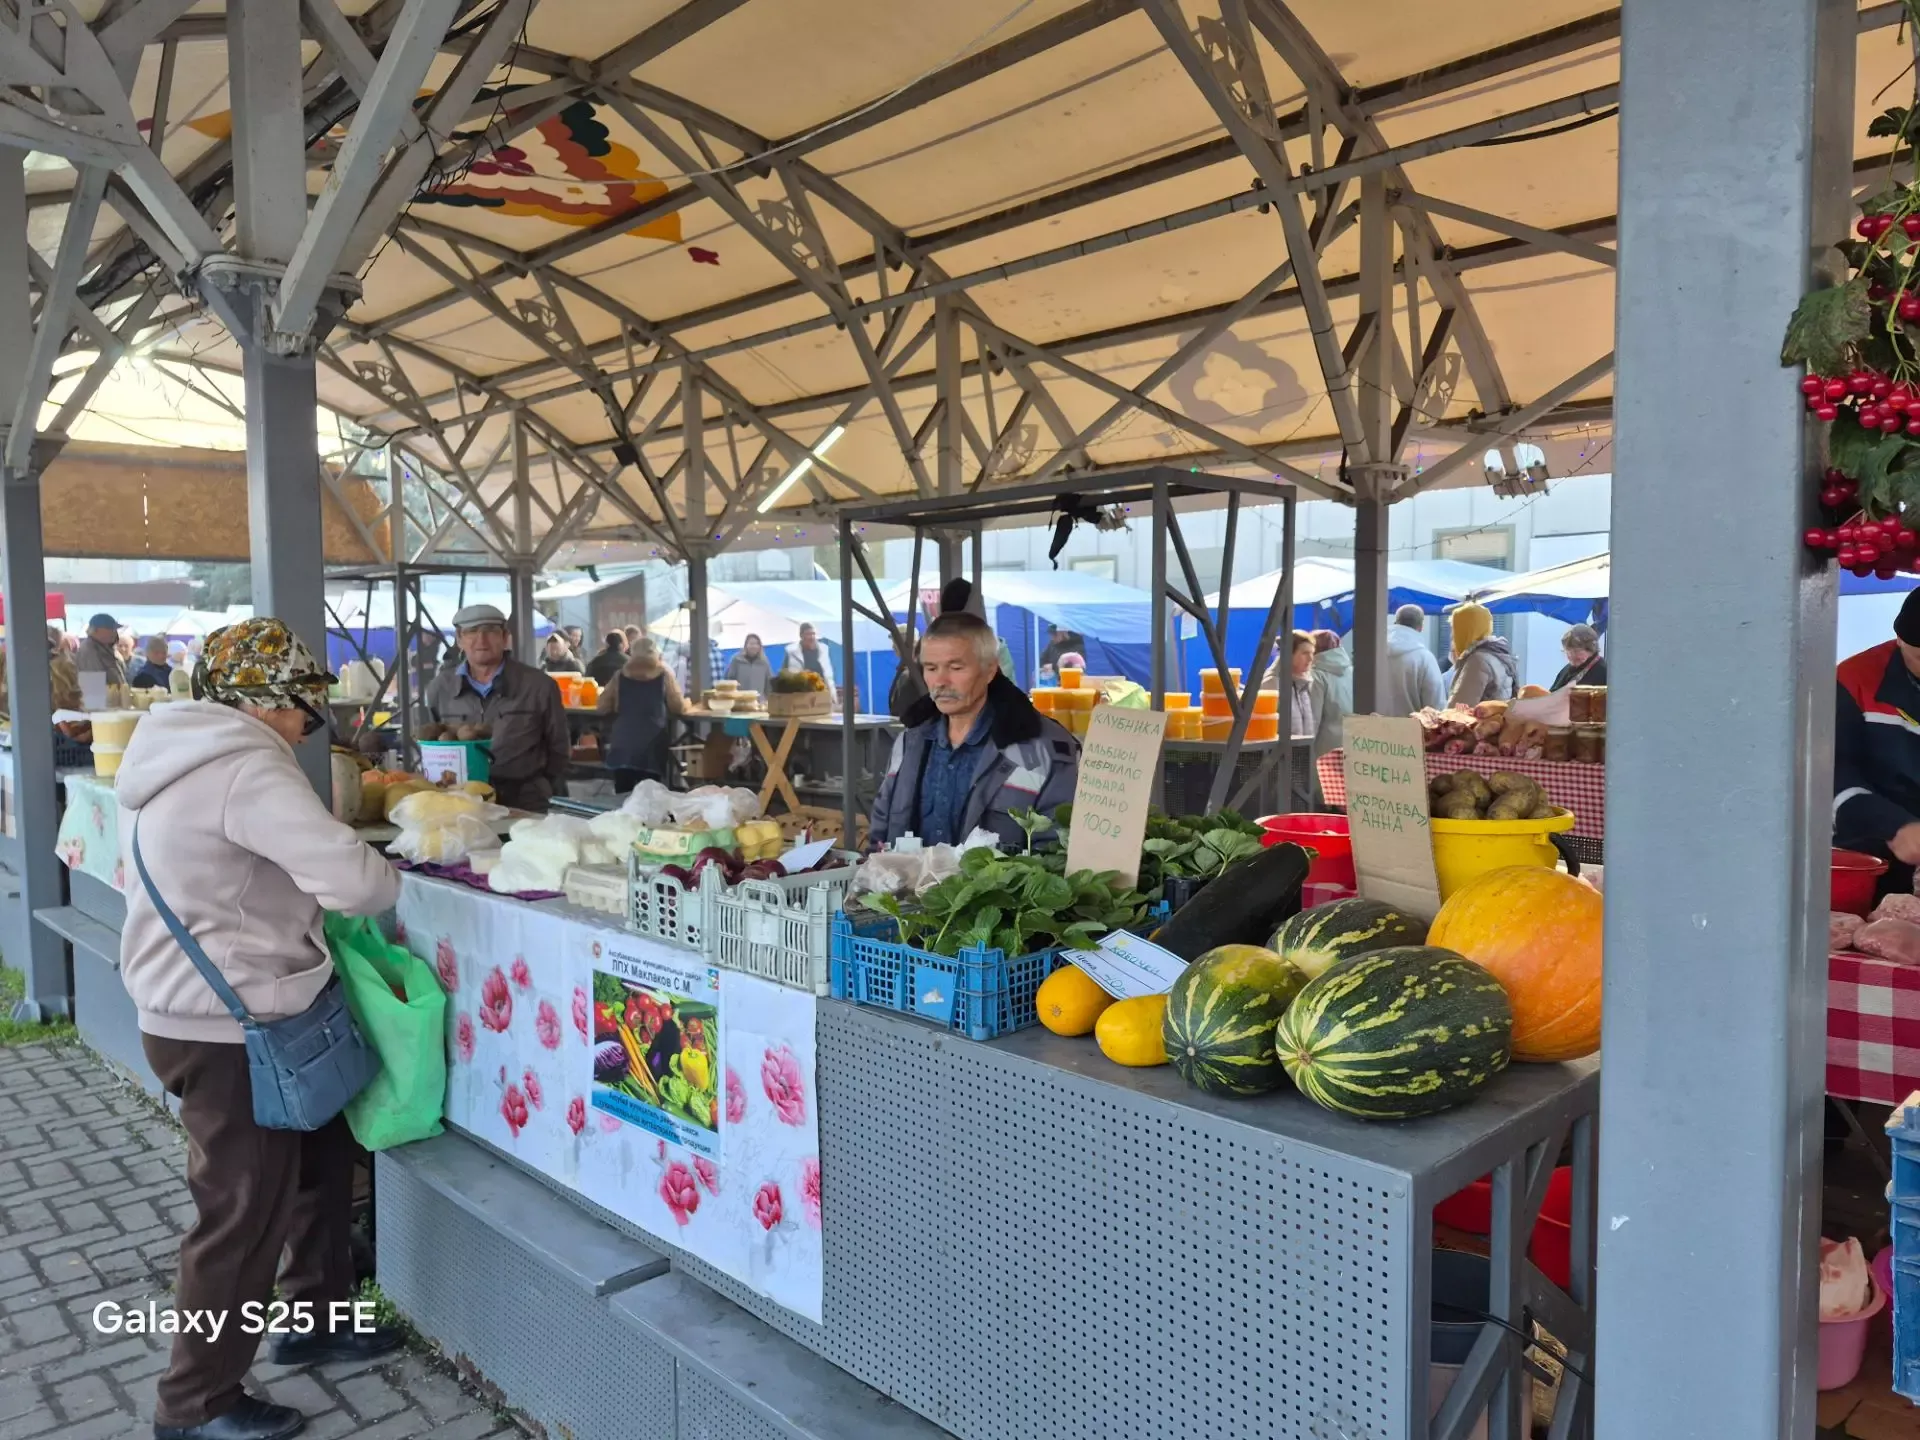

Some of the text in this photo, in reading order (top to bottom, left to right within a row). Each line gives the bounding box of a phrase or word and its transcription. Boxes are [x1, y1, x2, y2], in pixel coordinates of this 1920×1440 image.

[1094, 712, 1160, 736] КЛУБНИКА
[1352, 736, 1416, 759] КАРТОШКА
[1354, 761, 1412, 785] СЕМЕНА
[1078, 788, 1129, 813] МУРАНО
[1361, 808, 1404, 832] АННА
[612, 959, 629, 977] ЛПХ
[631, 965, 672, 988] Маклаков
